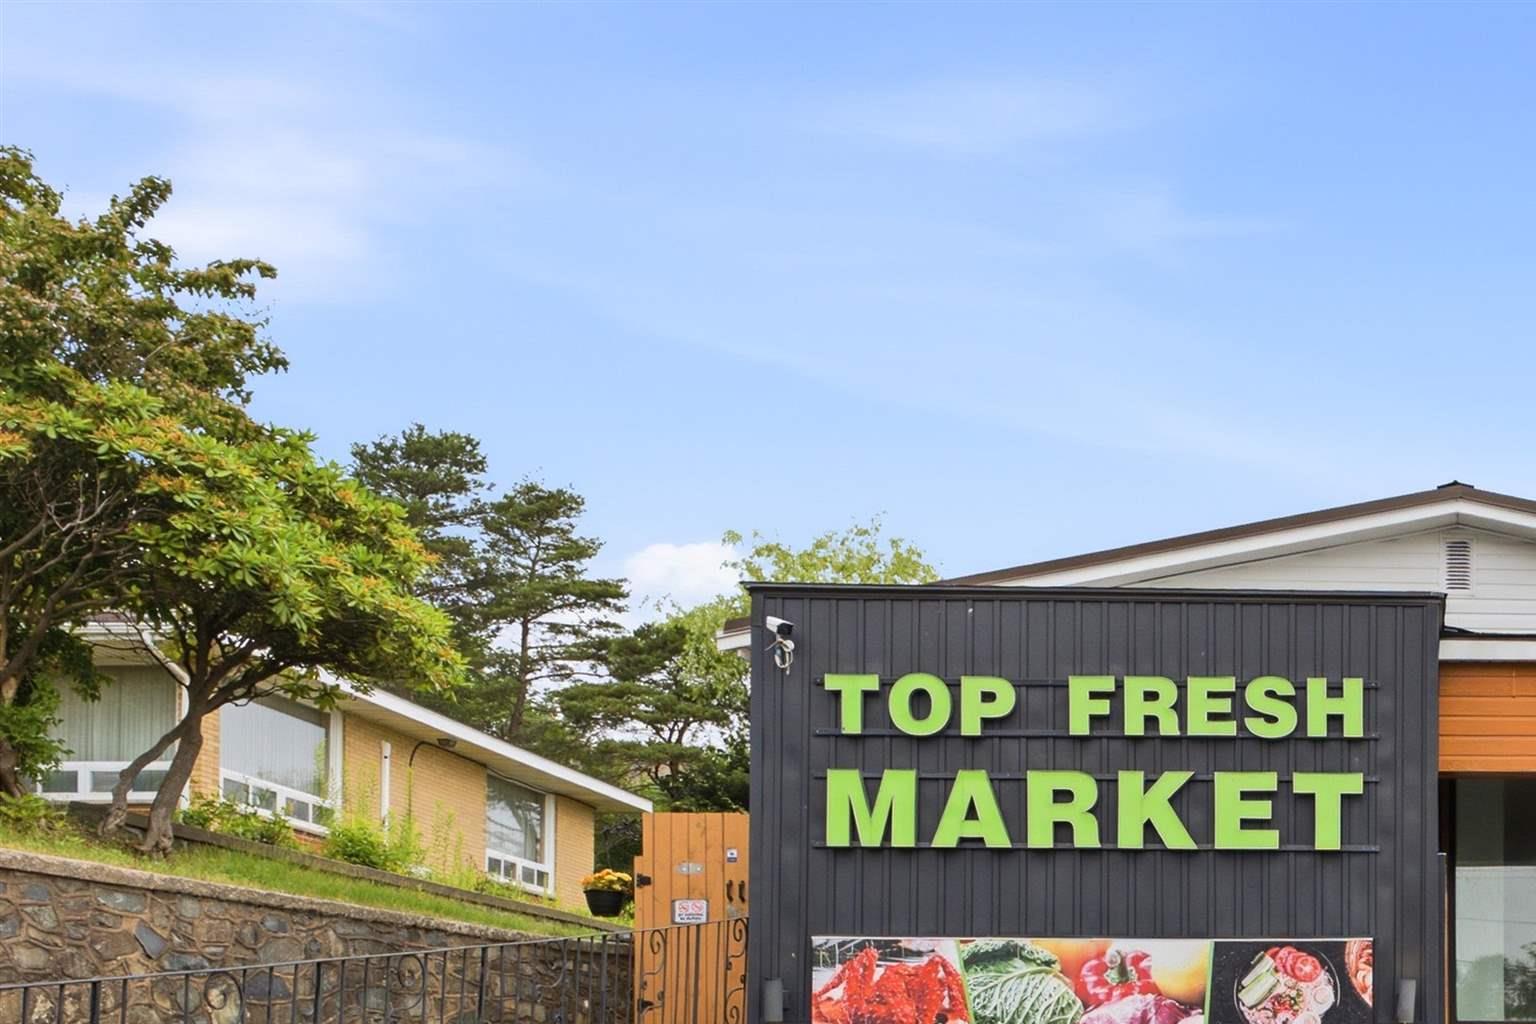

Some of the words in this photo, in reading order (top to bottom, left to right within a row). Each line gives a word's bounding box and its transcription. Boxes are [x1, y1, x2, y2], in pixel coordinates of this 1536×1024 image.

[823, 672, 1017, 737] TOP
[1067, 674, 1365, 739] FRESH
[825, 768, 1365, 851] MARKET
